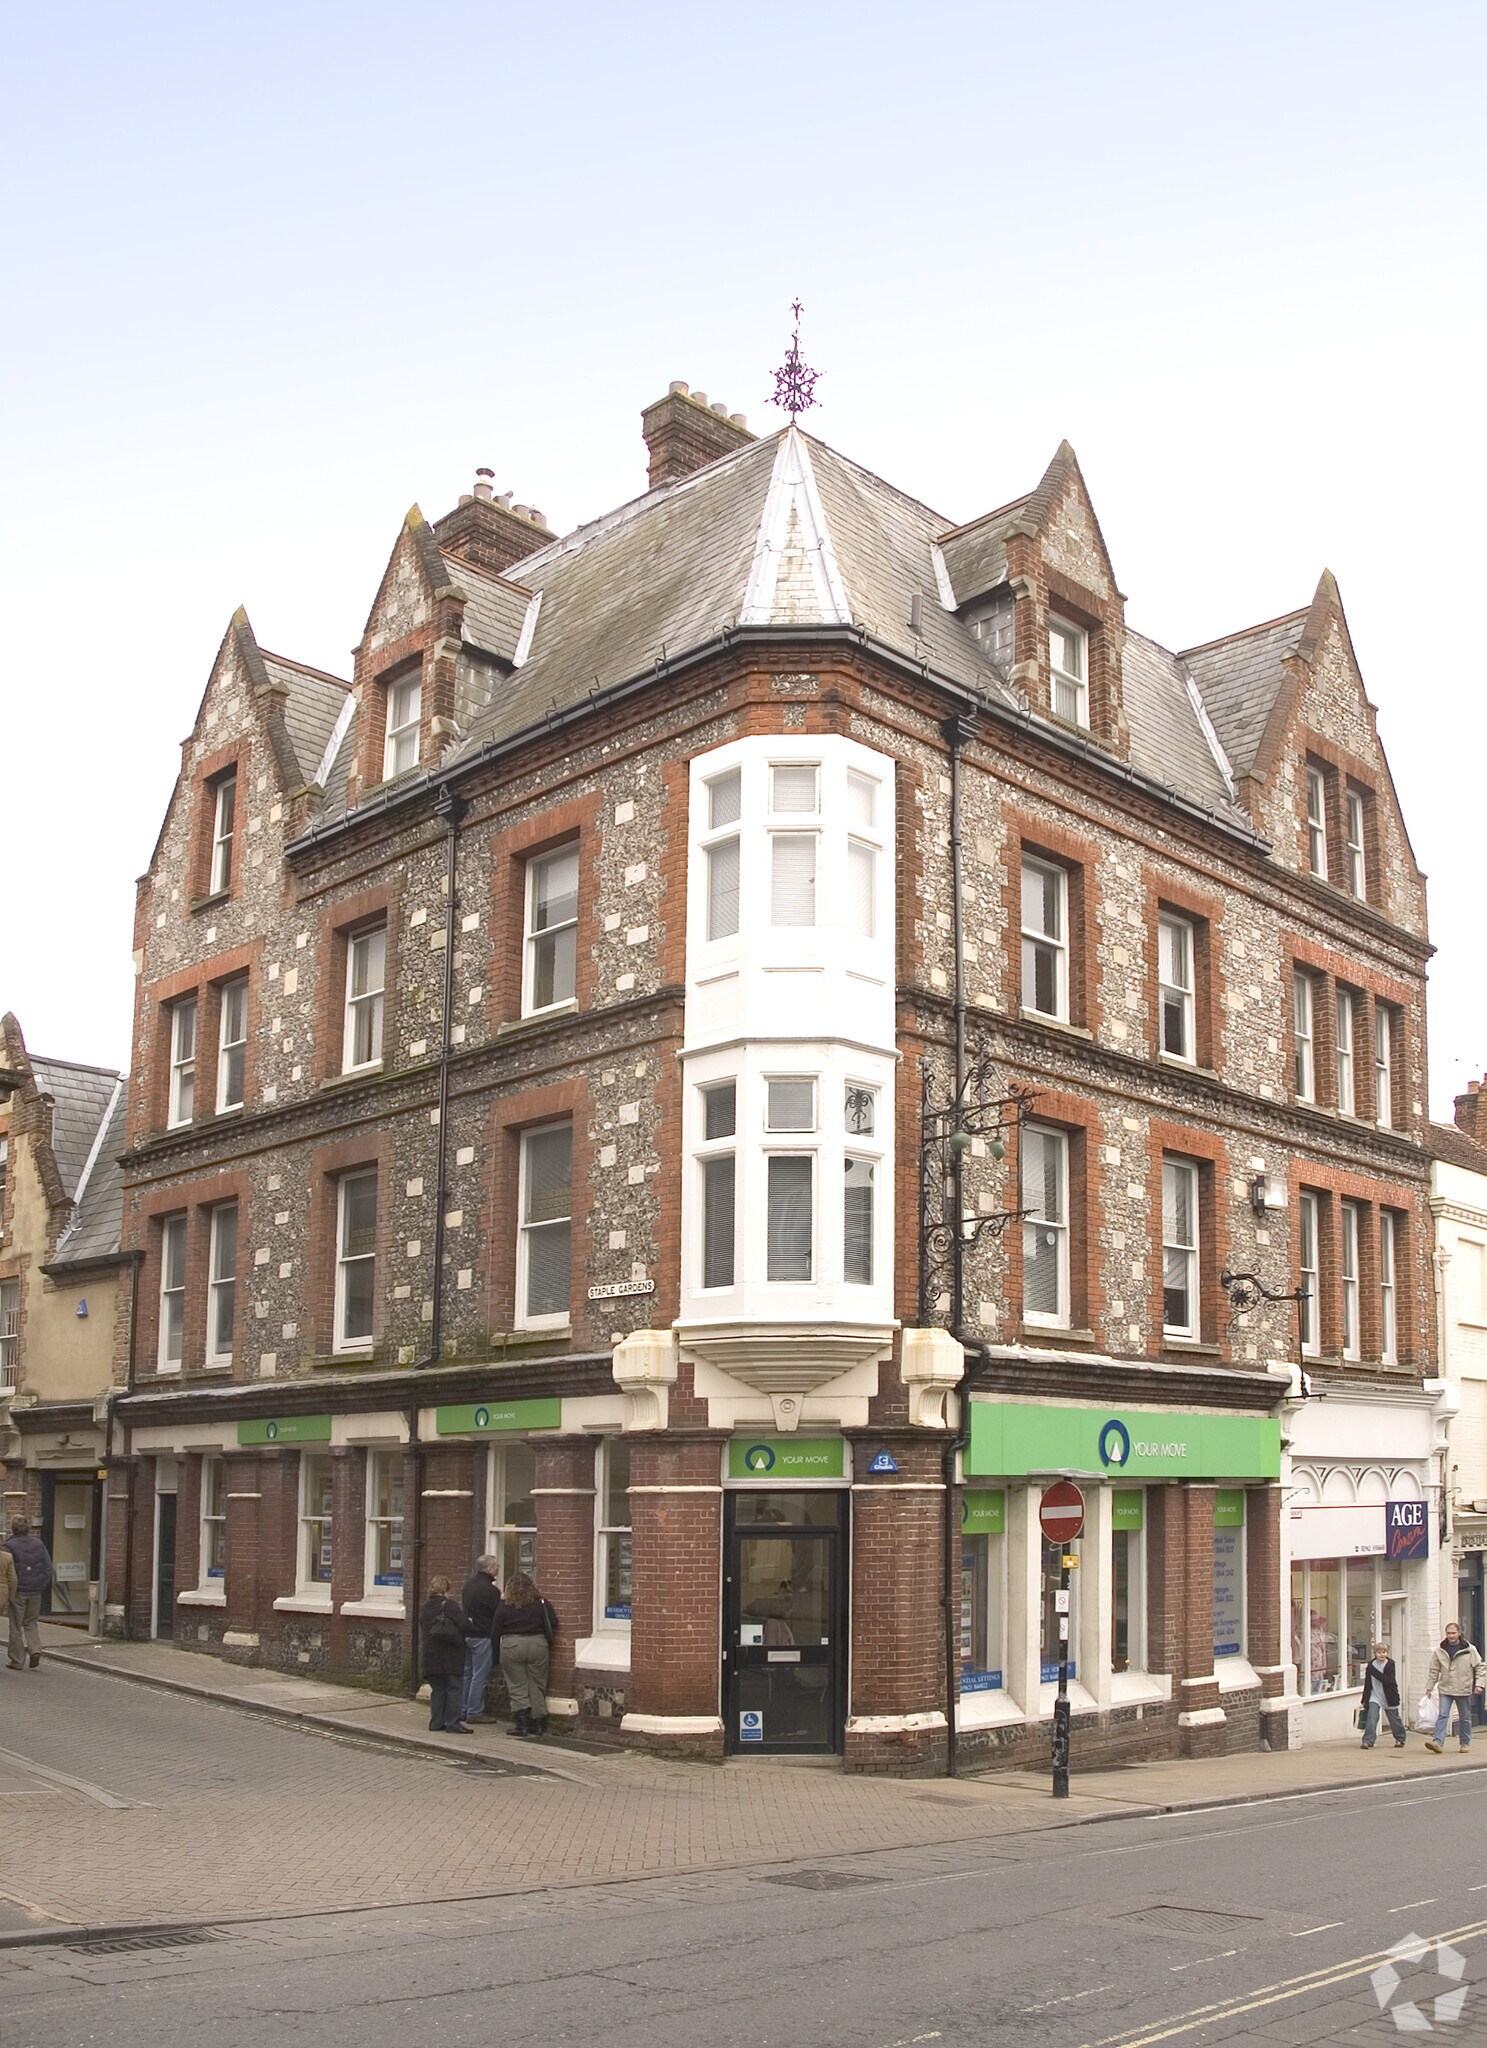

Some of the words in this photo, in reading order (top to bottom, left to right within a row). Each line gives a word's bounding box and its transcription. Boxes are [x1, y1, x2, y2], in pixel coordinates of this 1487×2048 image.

[590, 1286, 615, 1297] STAPLE
[619, 1281, 652, 1294] GARDENS
[1133, 1442, 1158, 1457] YOUR
[1161, 1443, 1187, 1457] MOVE
[782, 1456, 804, 1464] YOUR
[805, 1456, 829, 1464] MOVE
[1391, 1503, 1423, 1526] AGE
